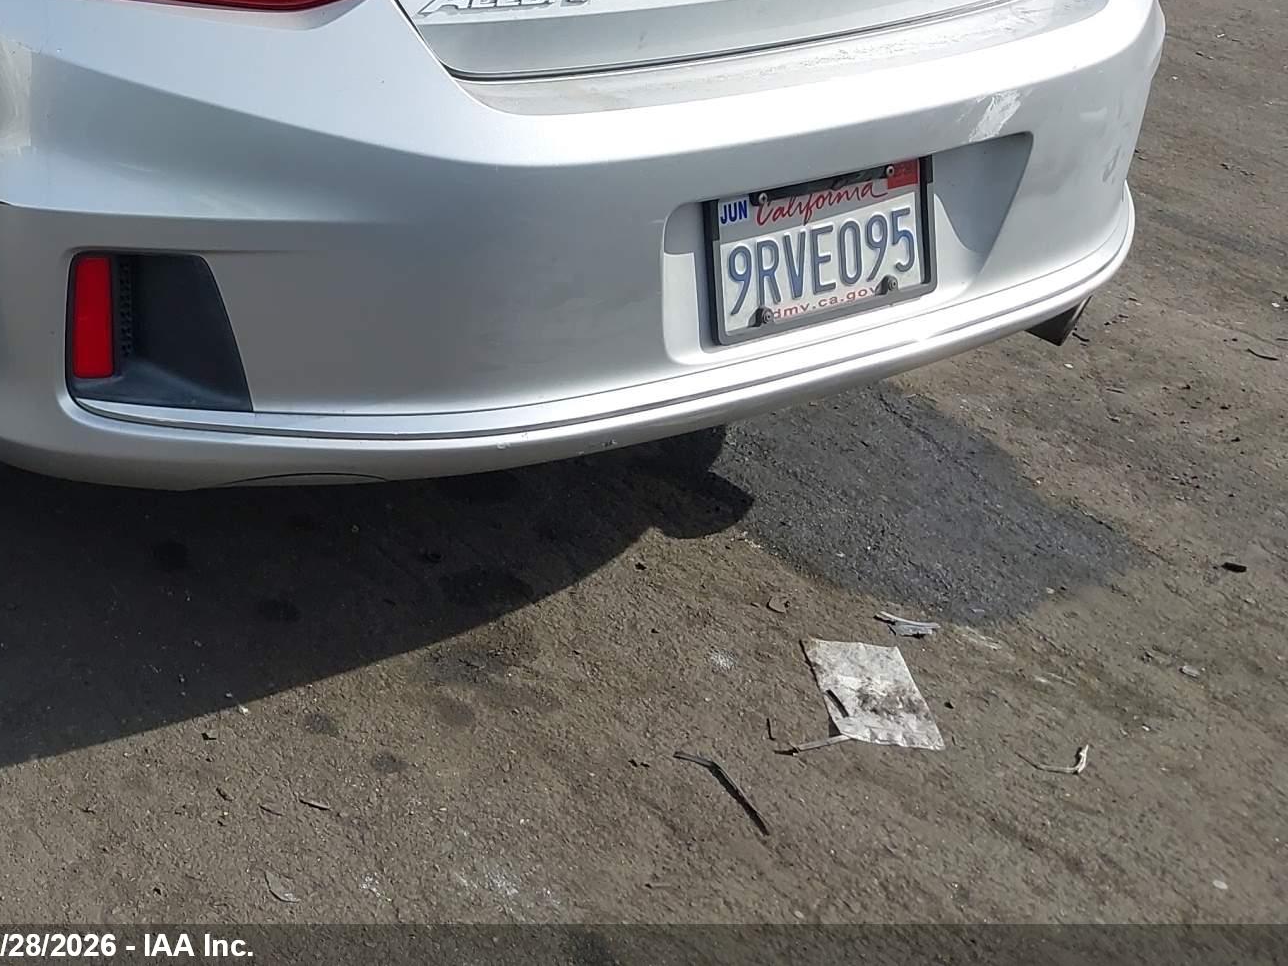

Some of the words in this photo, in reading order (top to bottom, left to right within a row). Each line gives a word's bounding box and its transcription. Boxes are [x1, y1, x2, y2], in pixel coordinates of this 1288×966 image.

[720, 200, 748, 224] JUN
[756, 181, 889, 227] California
[728, 207, 916, 316] 9RVE095
